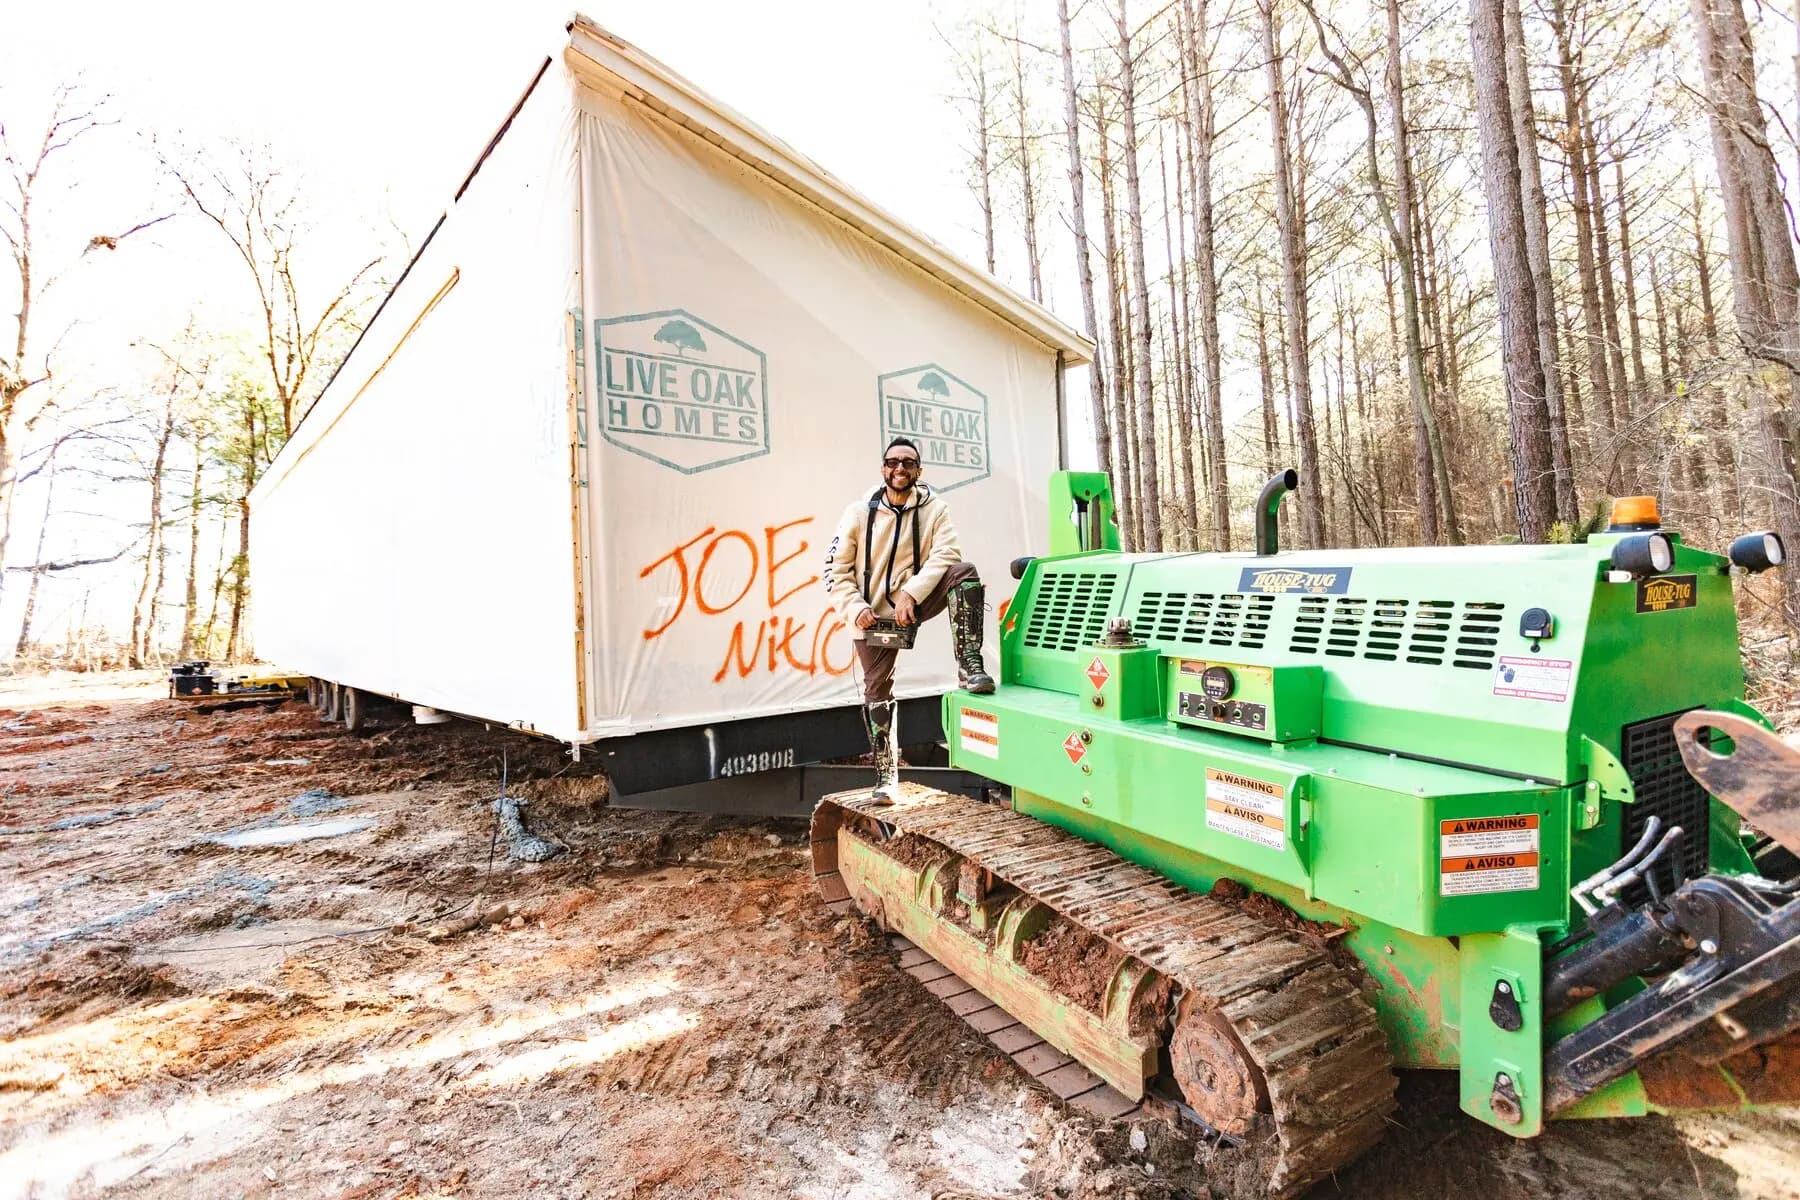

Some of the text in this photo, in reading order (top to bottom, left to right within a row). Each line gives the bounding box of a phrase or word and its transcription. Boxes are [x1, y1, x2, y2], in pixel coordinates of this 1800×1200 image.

[605, 354, 757, 409] LIVE OAK
[607, 398, 757, 440] HOMES
[887, 400, 981, 441] LIVE OAK
[889, 435, 983, 466] OMES
[639, 517, 819, 641] JOE
[1253, 573, 1337, 588] HOUSE-TUG
[1645, 582, 1692, 602] HOUSE-TUG
[1224, 774, 1274, 794] WARNING
[1233, 808, 1264, 823] AVISO
[1466, 818, 1527, 831] WARNING
[1477, 856, 1516, 869] AVISO
